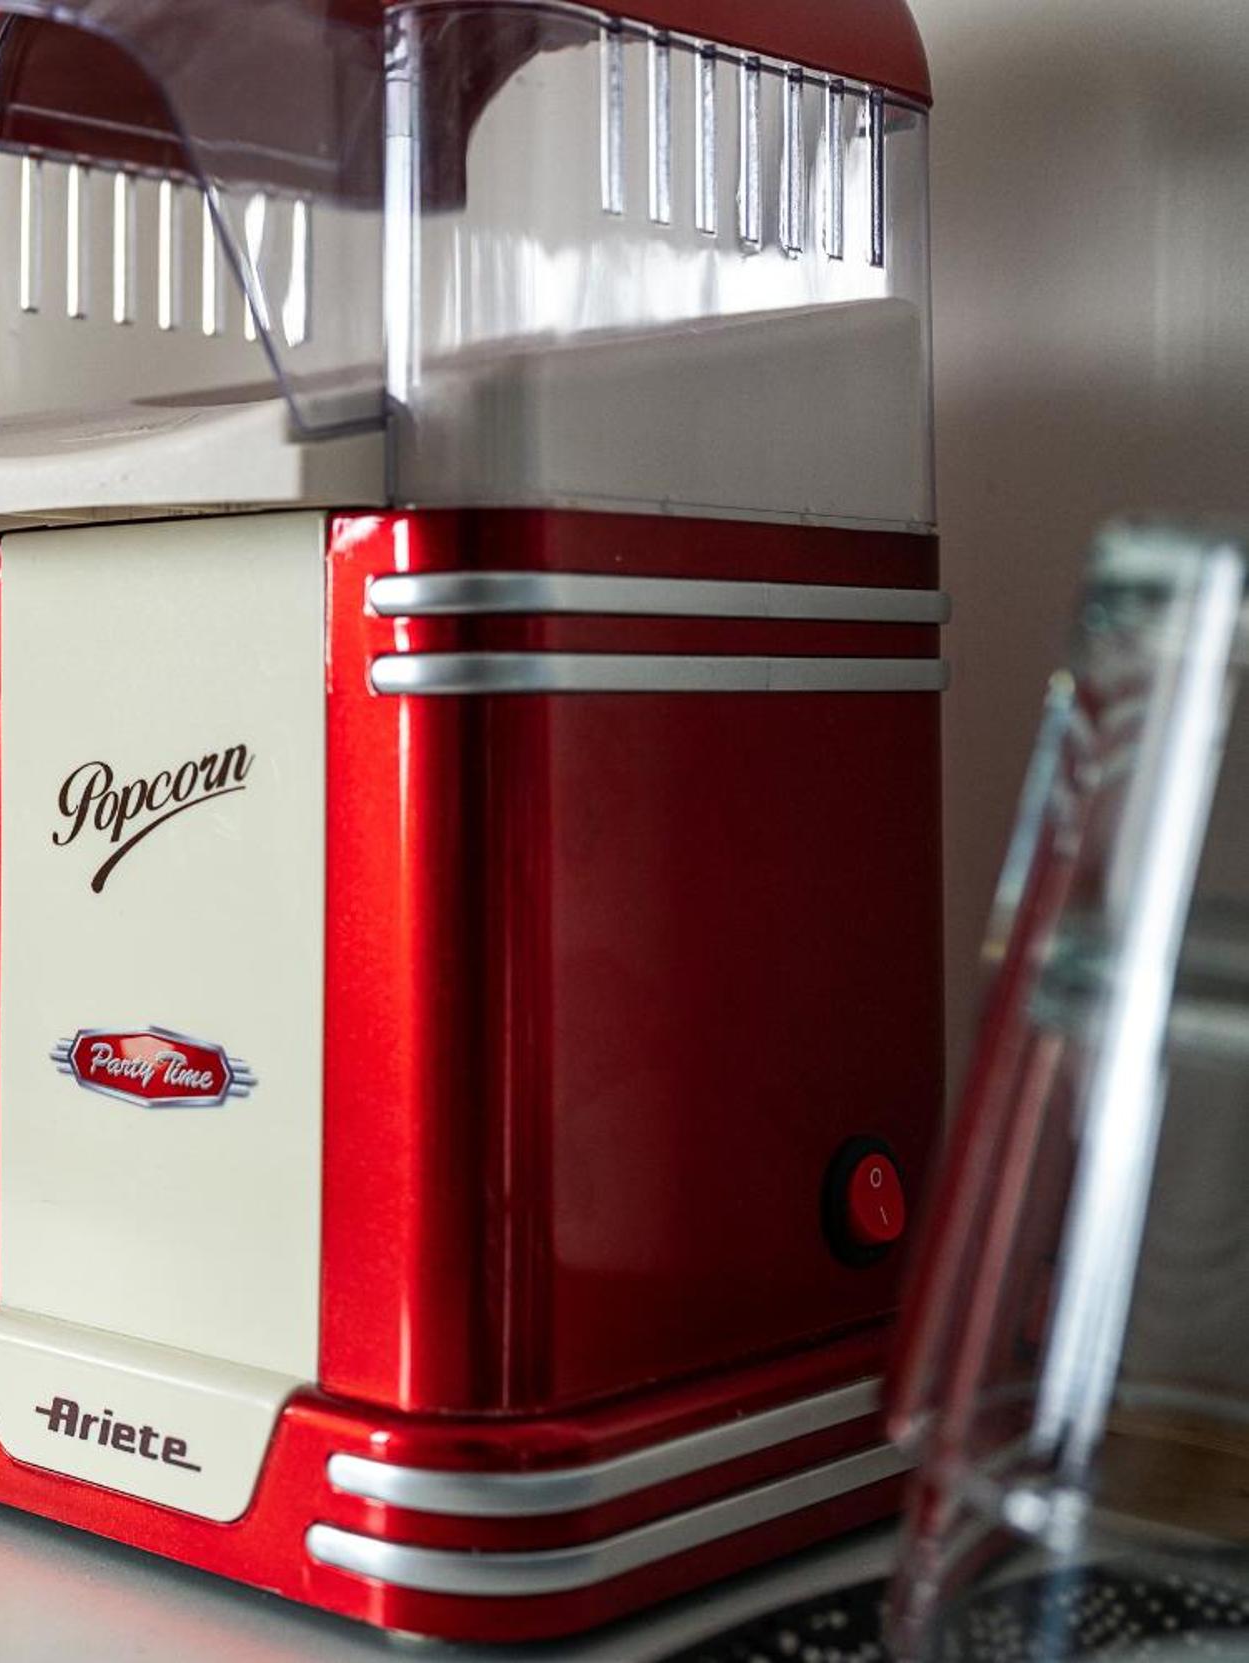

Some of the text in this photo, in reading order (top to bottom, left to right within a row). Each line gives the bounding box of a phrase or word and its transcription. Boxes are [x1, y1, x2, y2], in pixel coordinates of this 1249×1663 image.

[52, 743, 256, 846] Popcorn
[90, 1042, 214, 1090] Party Time
[35, 1396, 202, 1473] Ariete
